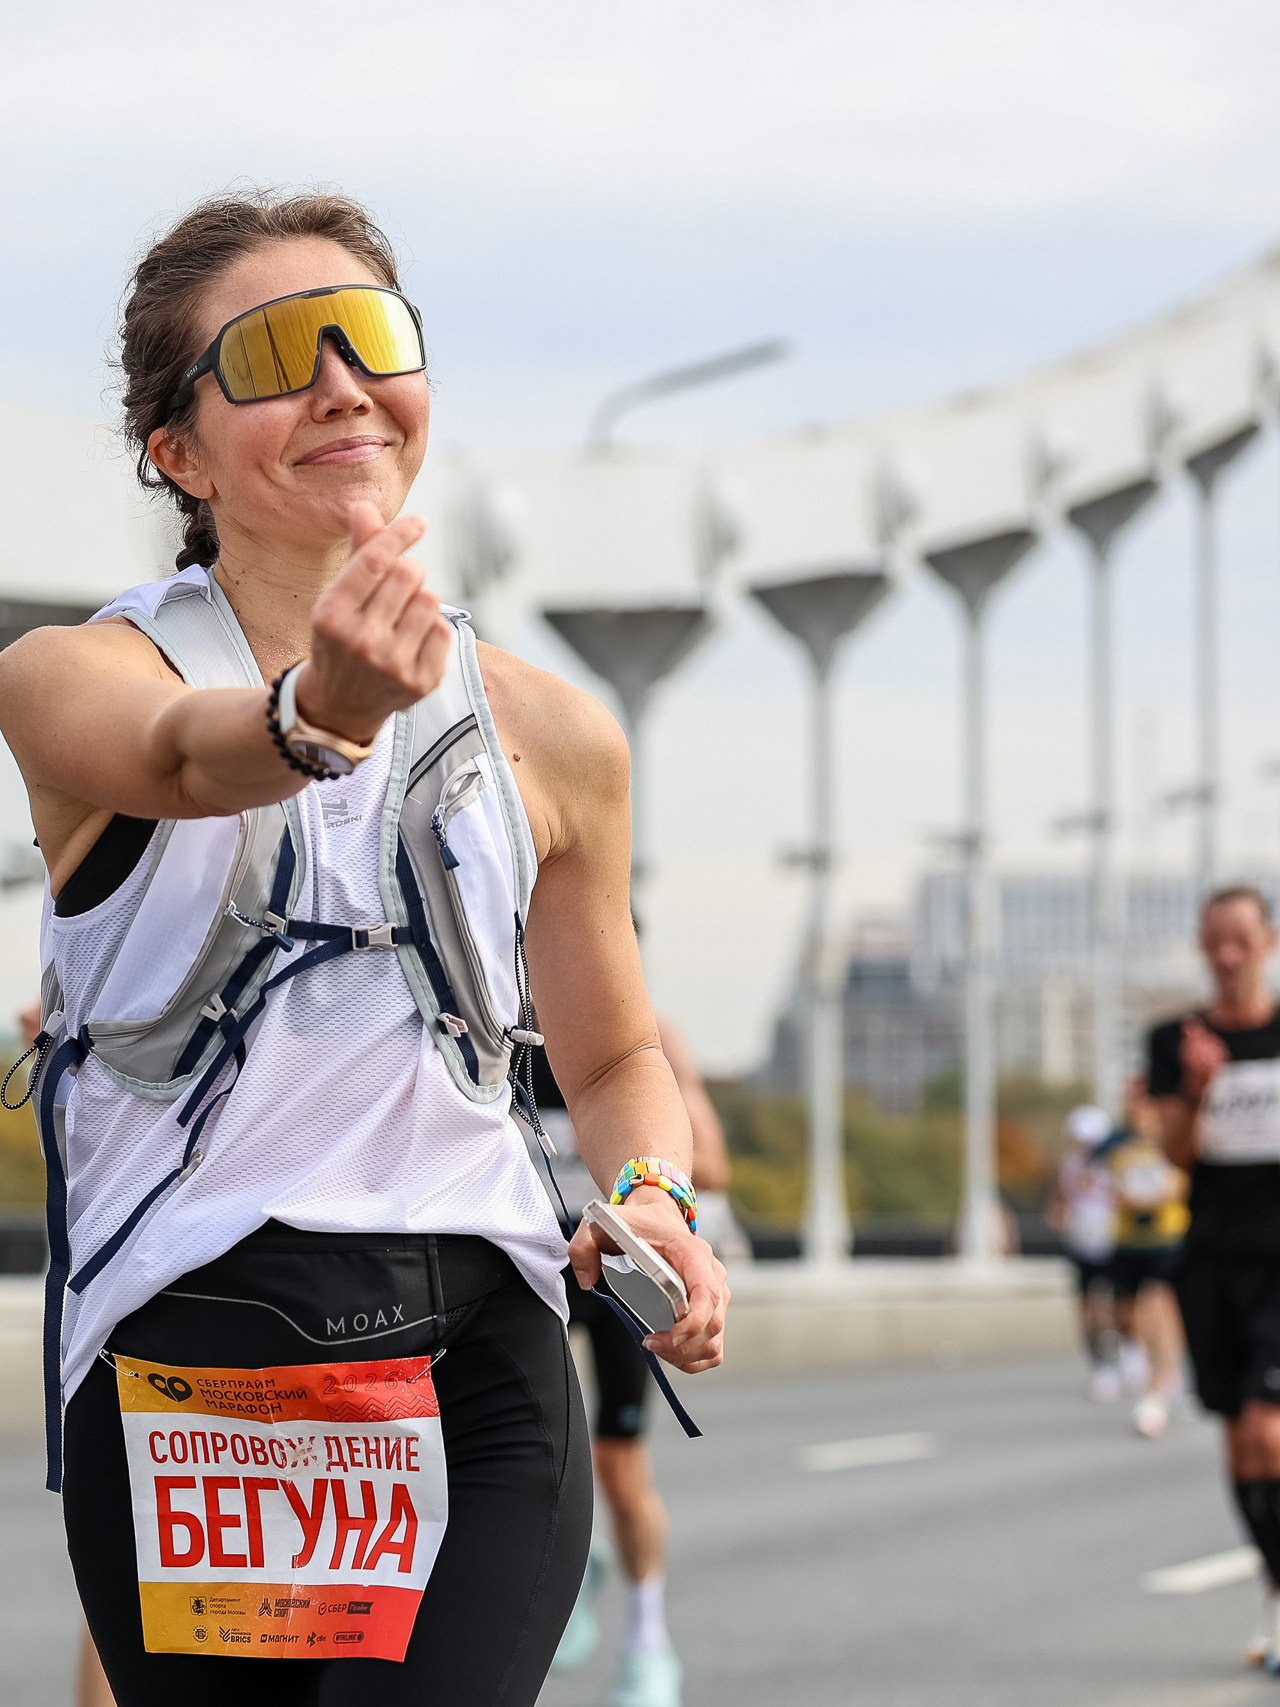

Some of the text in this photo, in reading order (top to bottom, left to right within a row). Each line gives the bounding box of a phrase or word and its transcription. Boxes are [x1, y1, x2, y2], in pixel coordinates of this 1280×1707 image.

[326, 1304, 405, 1336] MOAX
[196, 1378, 276, 1389] СБЕРПРАЙМ
[323, 1371, 399, 1394] 2026
[200, 1387, 308, 1401] МОСКОВСКИЙ
[205, 1400, 283, 1415] МАРАФОН
[149, 1430, 420, 1473] СОПРОВОЖДЕНИЕ
[153, 1475, 419, 1574] БЕГУНА
[275, 1597, 310, 1608] МОСКОВСКИЙ
[328, 1603, 347, 1613] СБЕР
[230, 1635, 252, 1643] BRICS
